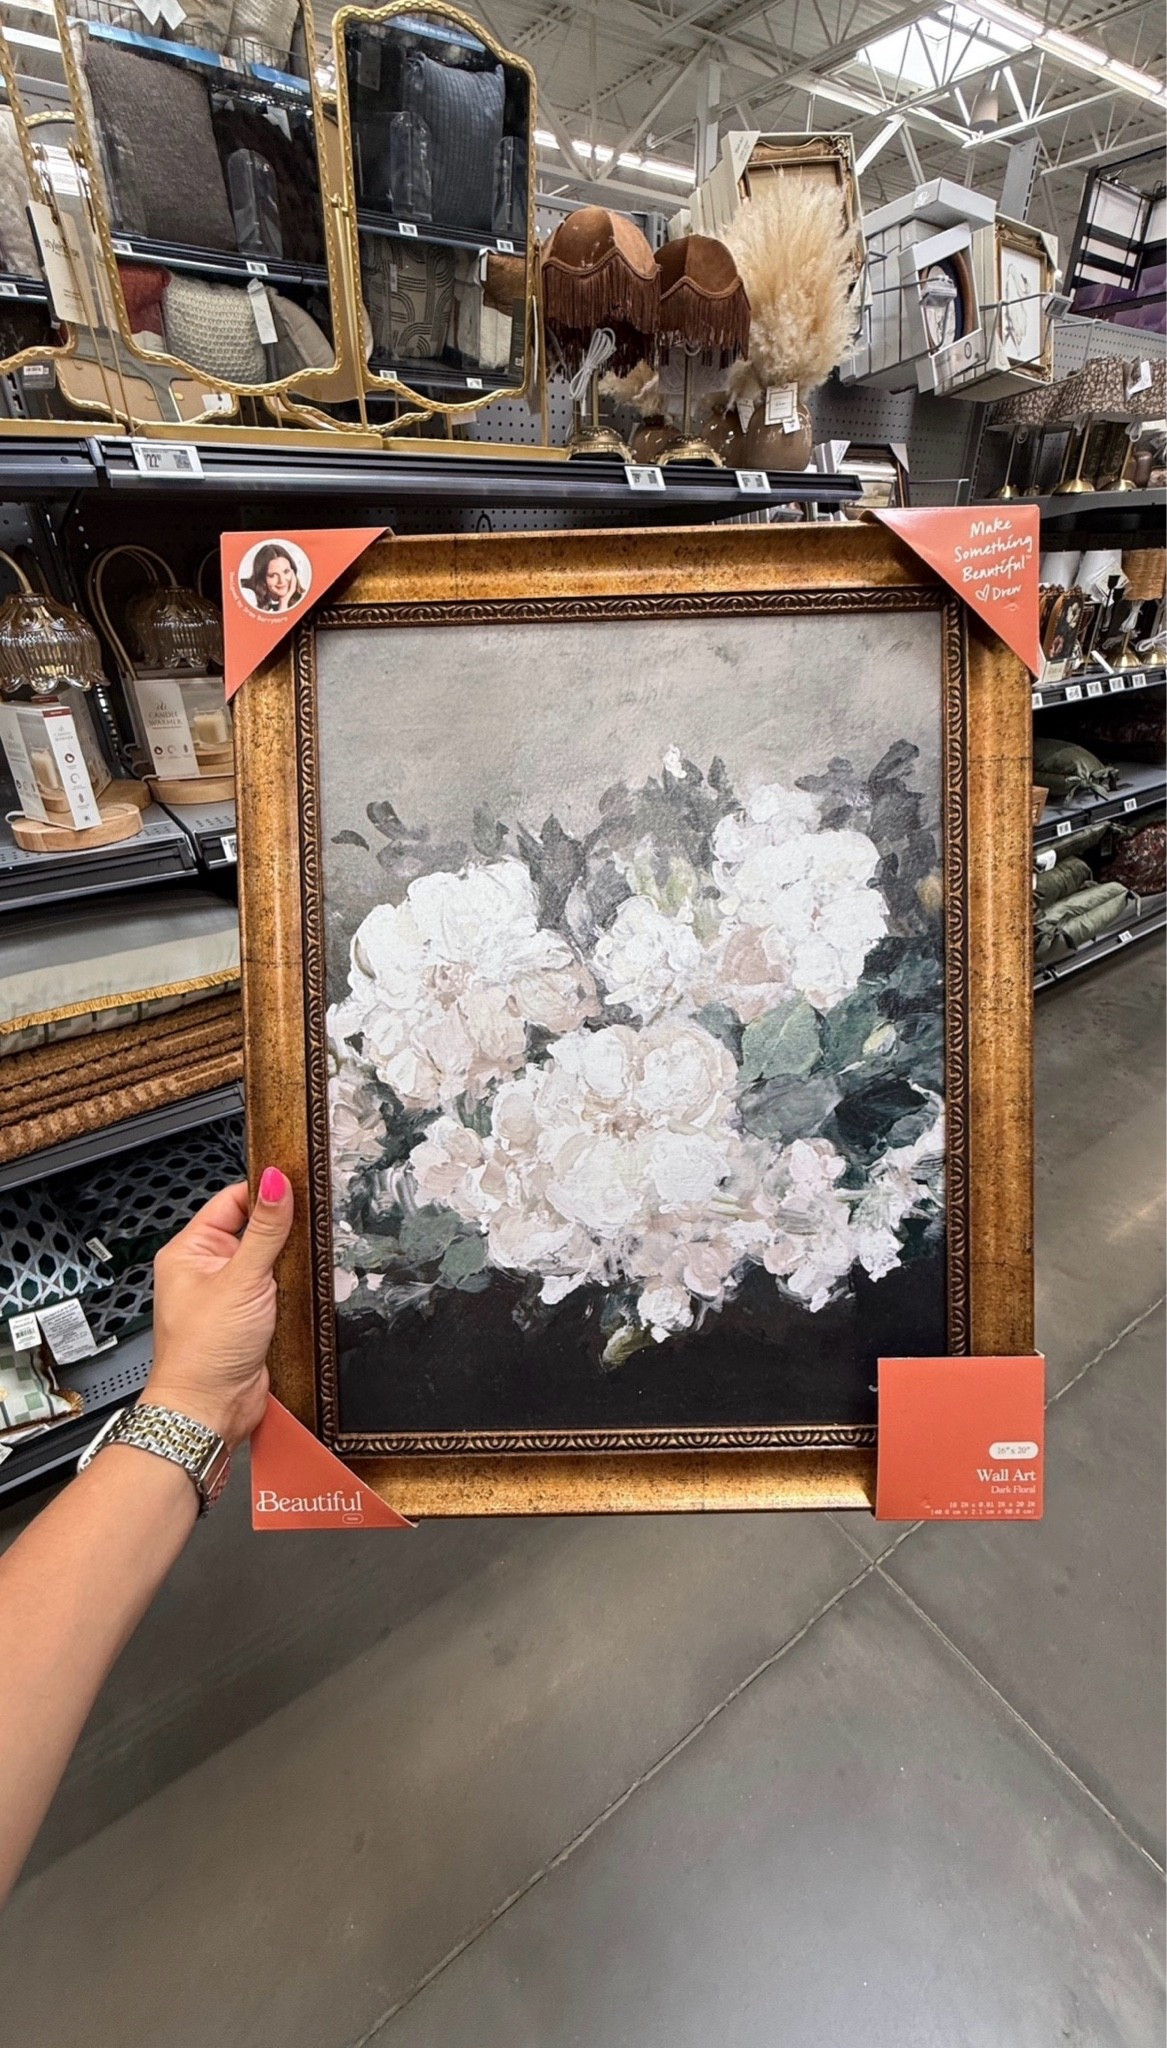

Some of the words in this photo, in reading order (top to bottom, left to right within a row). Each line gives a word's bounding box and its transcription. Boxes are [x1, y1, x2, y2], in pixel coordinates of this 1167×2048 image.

[970, 517, 1012, 538] Make
[954, 534, 1033, 562] Something
[962, 554, 1026, 582] Beautiful
[992, 585, 1022, 601] Drew
[976, 1468, 1009, 1482] Wall
[1012, 1468, 1037, 1482] Art
[991, 1485, 1012, 1494] Dark
[1013, 1485, 1036, 1494] Floral
[256, 1490, 363, 1512] Beautiful
